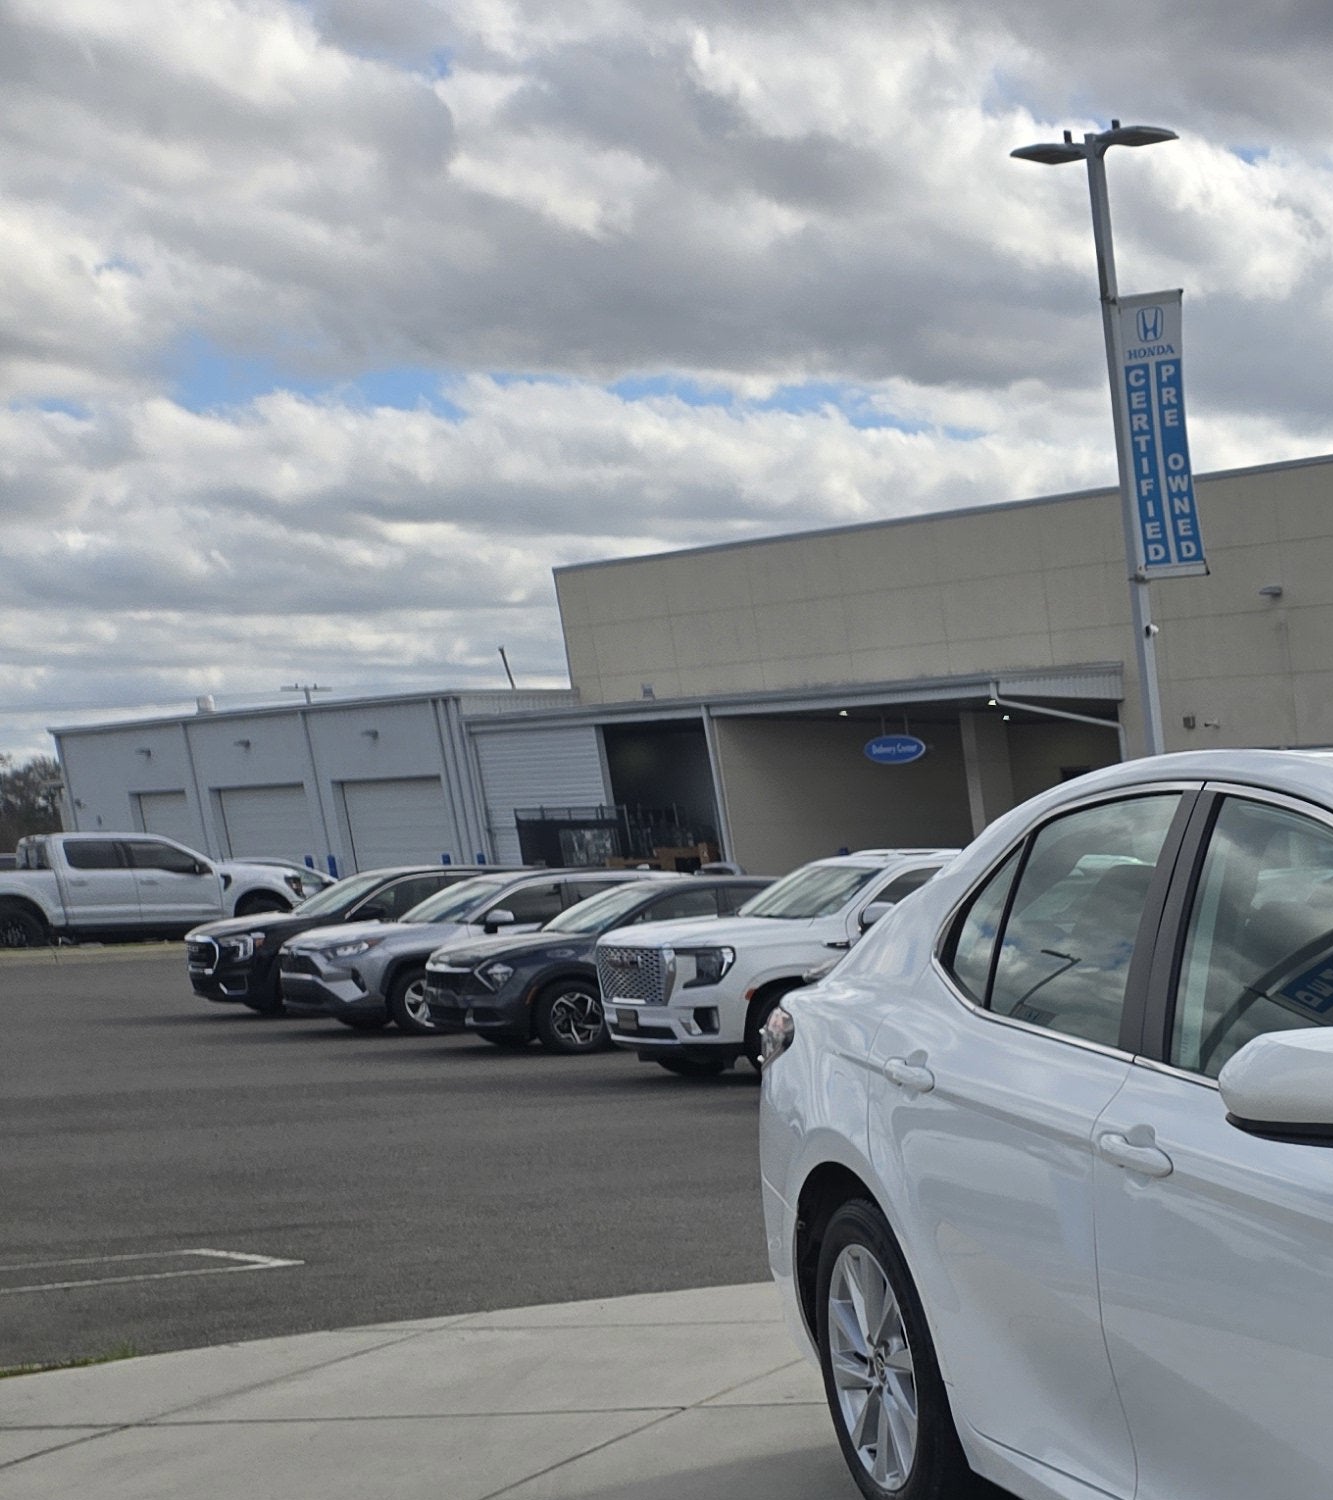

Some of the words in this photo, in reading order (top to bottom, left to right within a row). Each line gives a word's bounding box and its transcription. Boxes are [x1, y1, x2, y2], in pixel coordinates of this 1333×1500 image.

[1128, 344, 1174, 360] HONDA
[1161, 364, 1178, 428] PRE
[1127, 368, 1167, 562] CERTIFIED
[1167, 452, 1197, 559] OWNED
